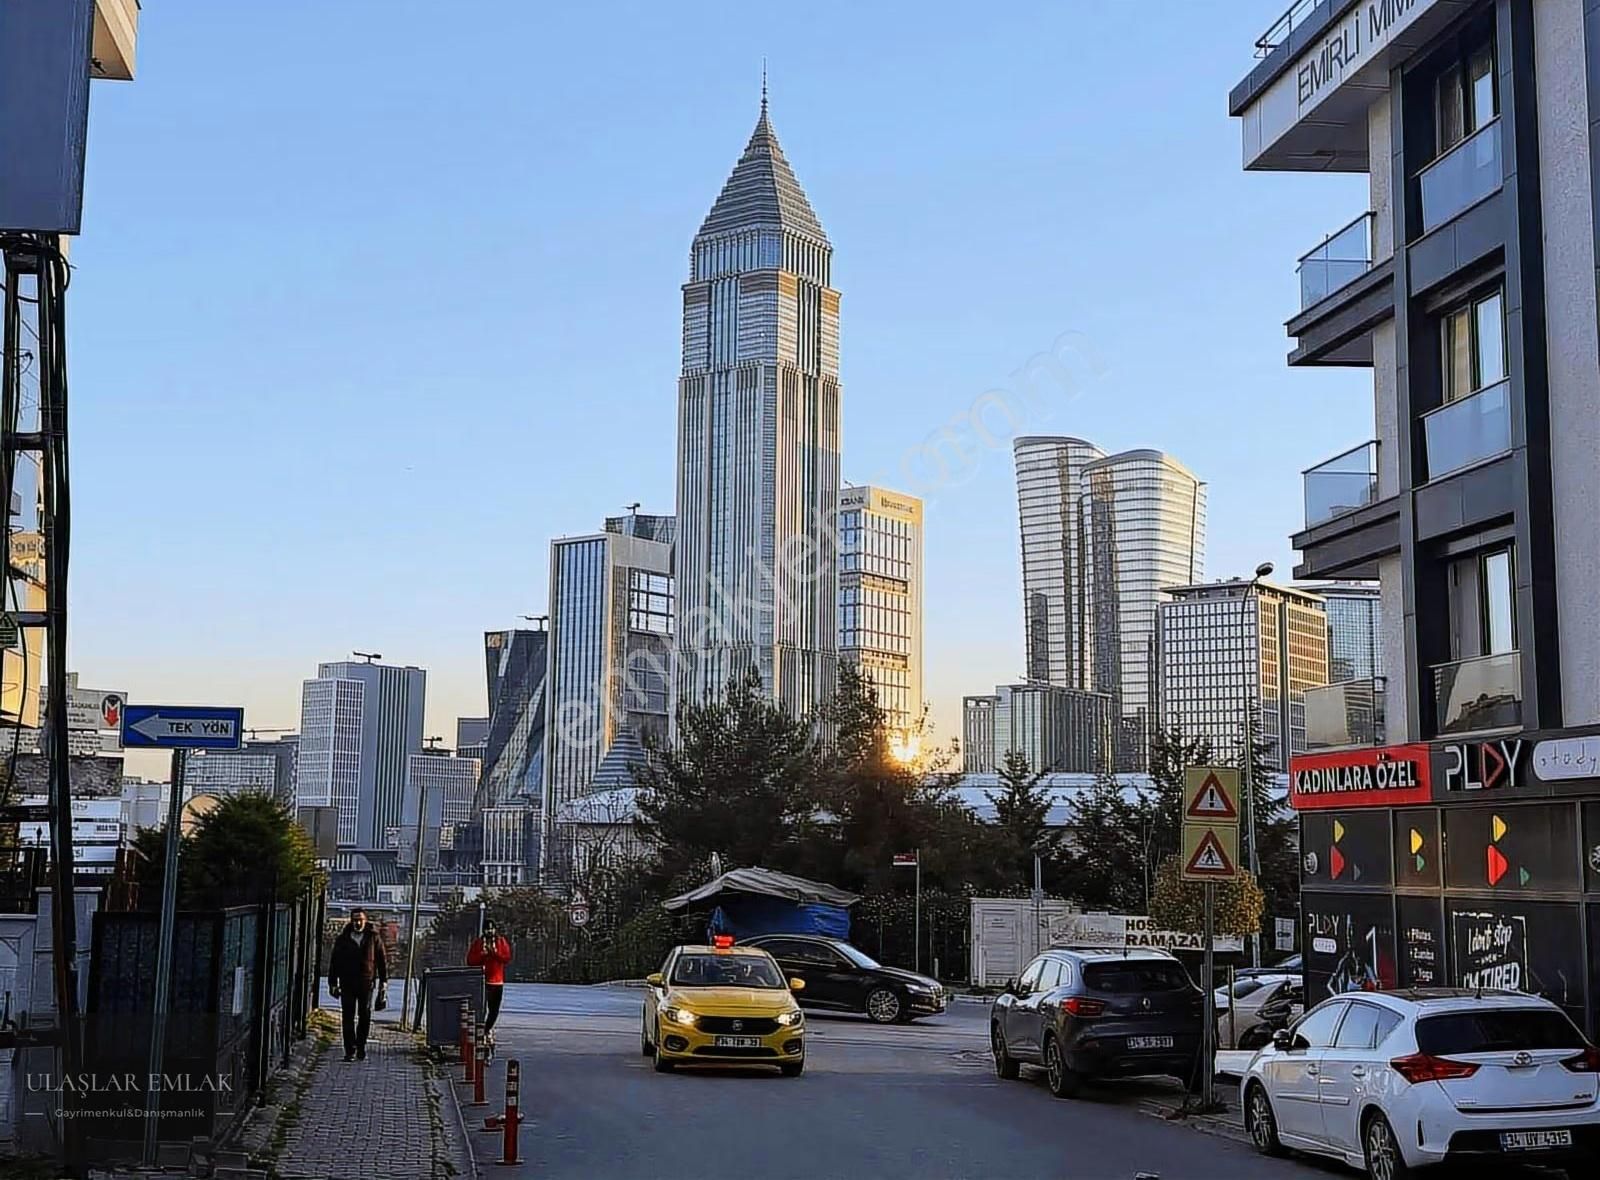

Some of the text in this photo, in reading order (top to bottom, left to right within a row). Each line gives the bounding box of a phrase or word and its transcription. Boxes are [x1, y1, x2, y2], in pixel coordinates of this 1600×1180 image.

[1297, 9, 1360, 107] EMİRLİ
[168, 720, 229, 734] TEK YÖN
[1294, 753, 1416, 795] KADINLARA ÖZEL
[1481, 961, 1521, 990] TIRED
[1508, 1133, 1521, 1147] 34
[1543, 1130, 1569, 1146] 4315
